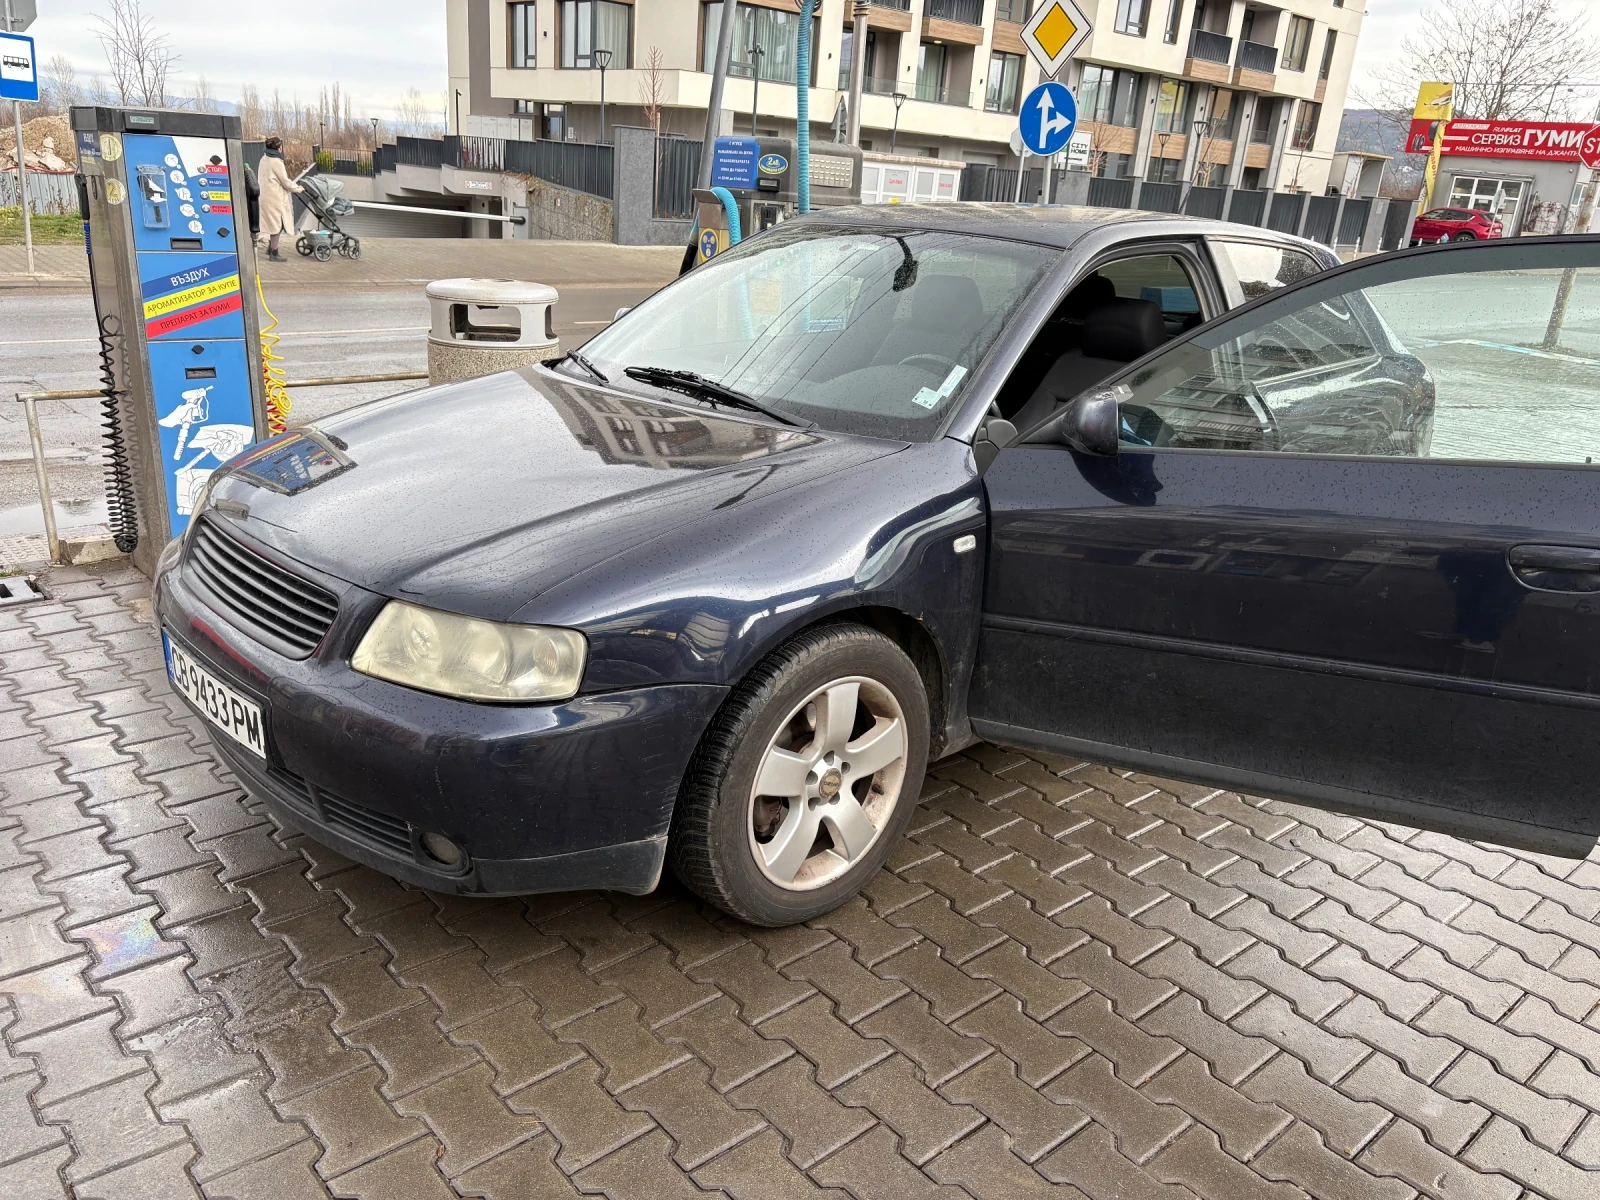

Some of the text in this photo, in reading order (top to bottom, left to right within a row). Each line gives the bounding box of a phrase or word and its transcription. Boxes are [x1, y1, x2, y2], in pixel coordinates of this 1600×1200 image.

[1471, 129, 1585, 148] СЕРВИЗ ГУМИ
[1493, 147, 1535, 155] ИЗПРАВЯНЕ
[170, 267, 210, 287] ВЪЗДУХ
[147, 279, 237, 313] АРОМАТИЗАТОР ЗА КУПЕ
[160, 302, 231, 330] ПРЕПАРАТ ЗА ГУМИ
